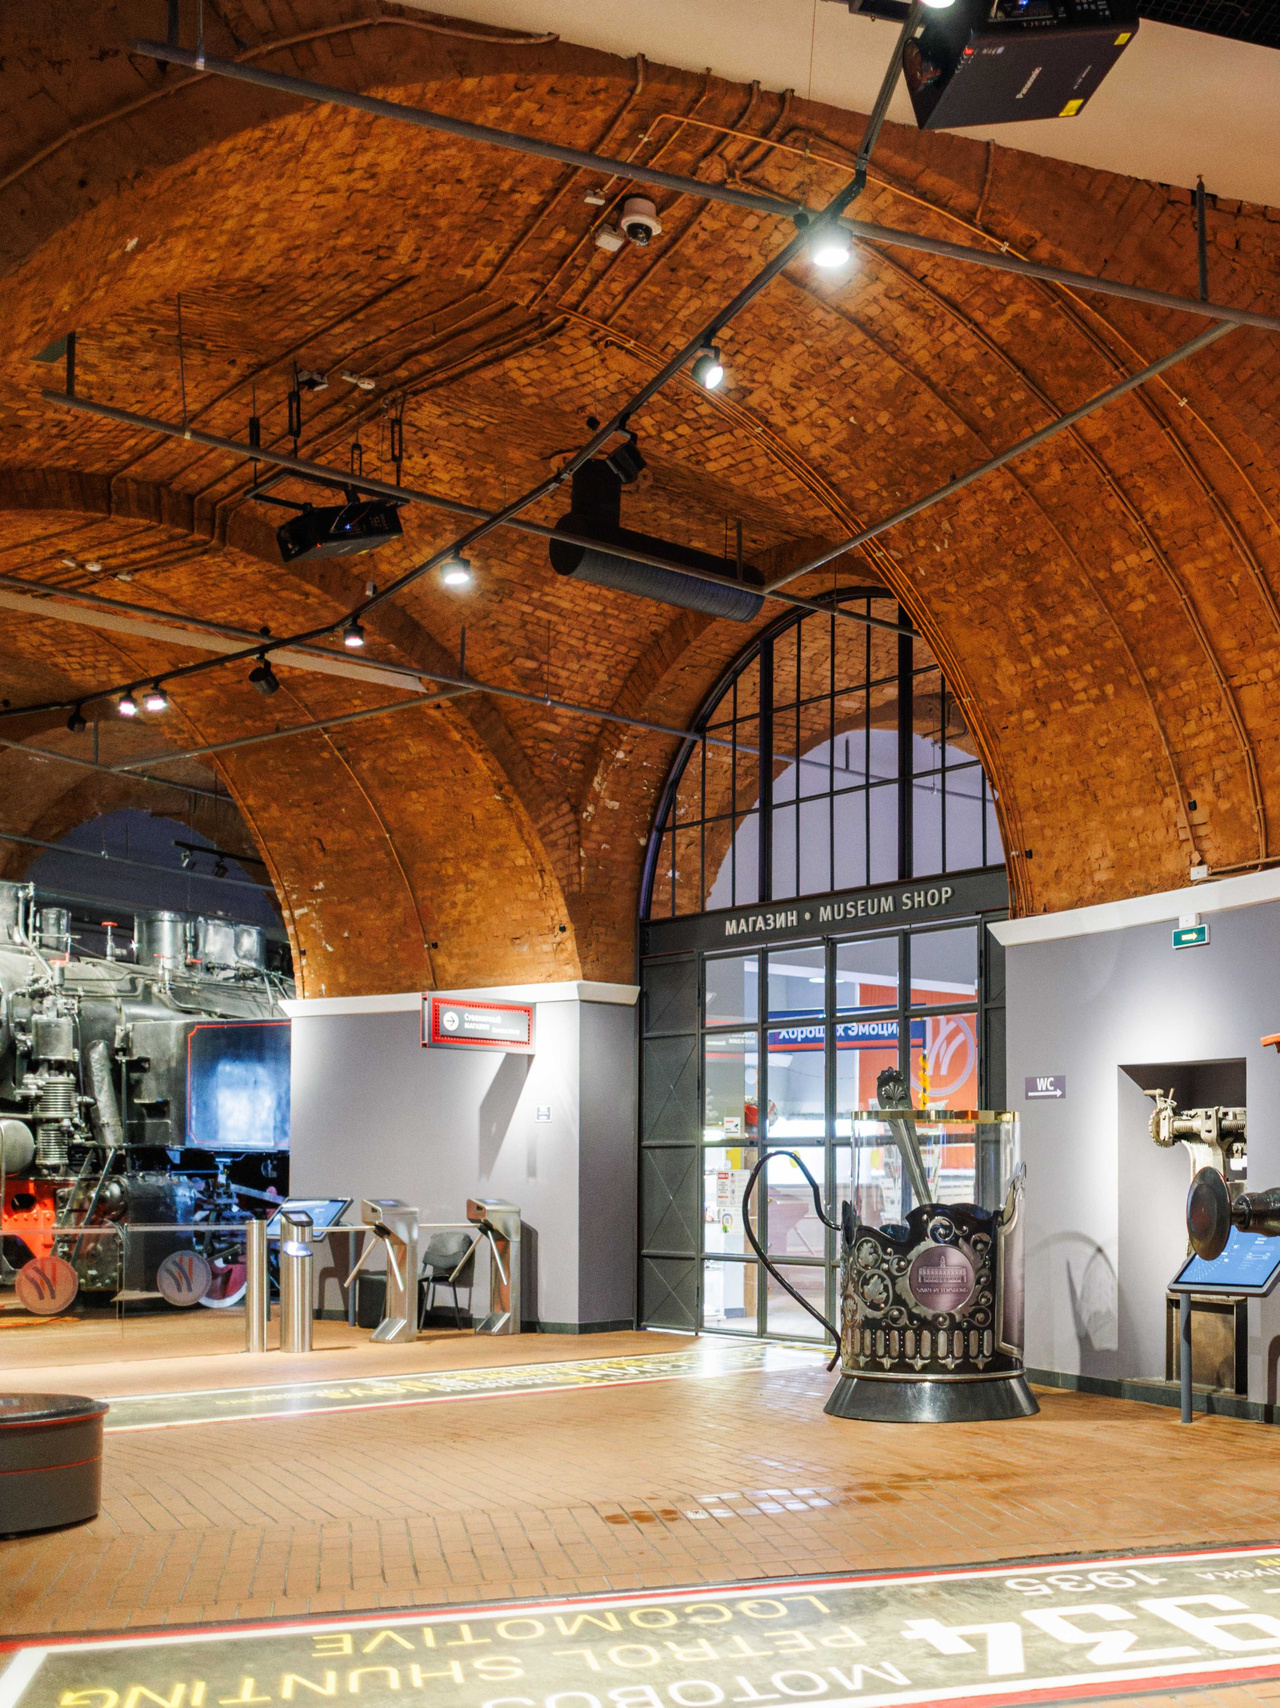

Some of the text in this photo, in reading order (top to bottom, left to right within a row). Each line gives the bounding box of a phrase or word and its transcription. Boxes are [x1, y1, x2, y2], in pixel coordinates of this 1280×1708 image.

[819, 887, 952, 922] MUSEUM SHOP
[725, 910, 798, 935] МАГАЗИН
[779, 1022, 899, 1042] Хорошх Эмоци
[1036, 1077, 1054, 1091] WC
[1005, 1568, 1168, 1596] 1935
[311, 1595, 831, 1658] LOCOMOTIVE
[60, 1625, 867, 1708] PETROL SHUNTING
